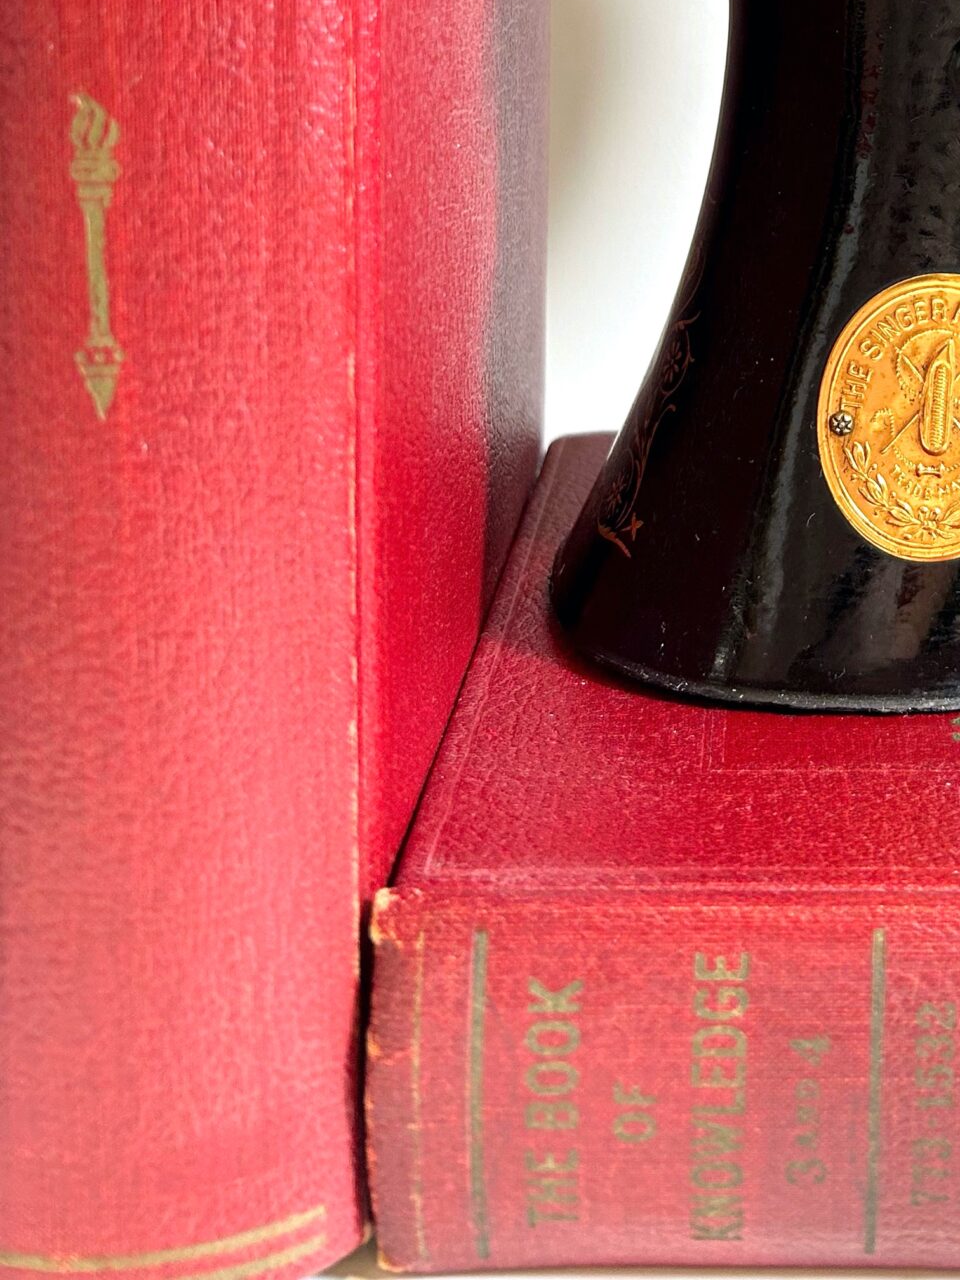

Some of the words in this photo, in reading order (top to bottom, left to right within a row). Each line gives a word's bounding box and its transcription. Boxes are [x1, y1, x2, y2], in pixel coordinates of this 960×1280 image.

[841, 360, 873, 410] THE
[859, 297, 949, 362] SINGER
[524, 977, 583, 1131] BOOK
[789, 1033, 832, 1067] 4
[612, 1082, 658, 1144] OF
[689, 951, 752, 1241] KNOWLEDGE
[795, 1077, 821, 1151] AND
[525, 1148, 580, 1228] THE
[785, 1156, 828, 1186] 3
